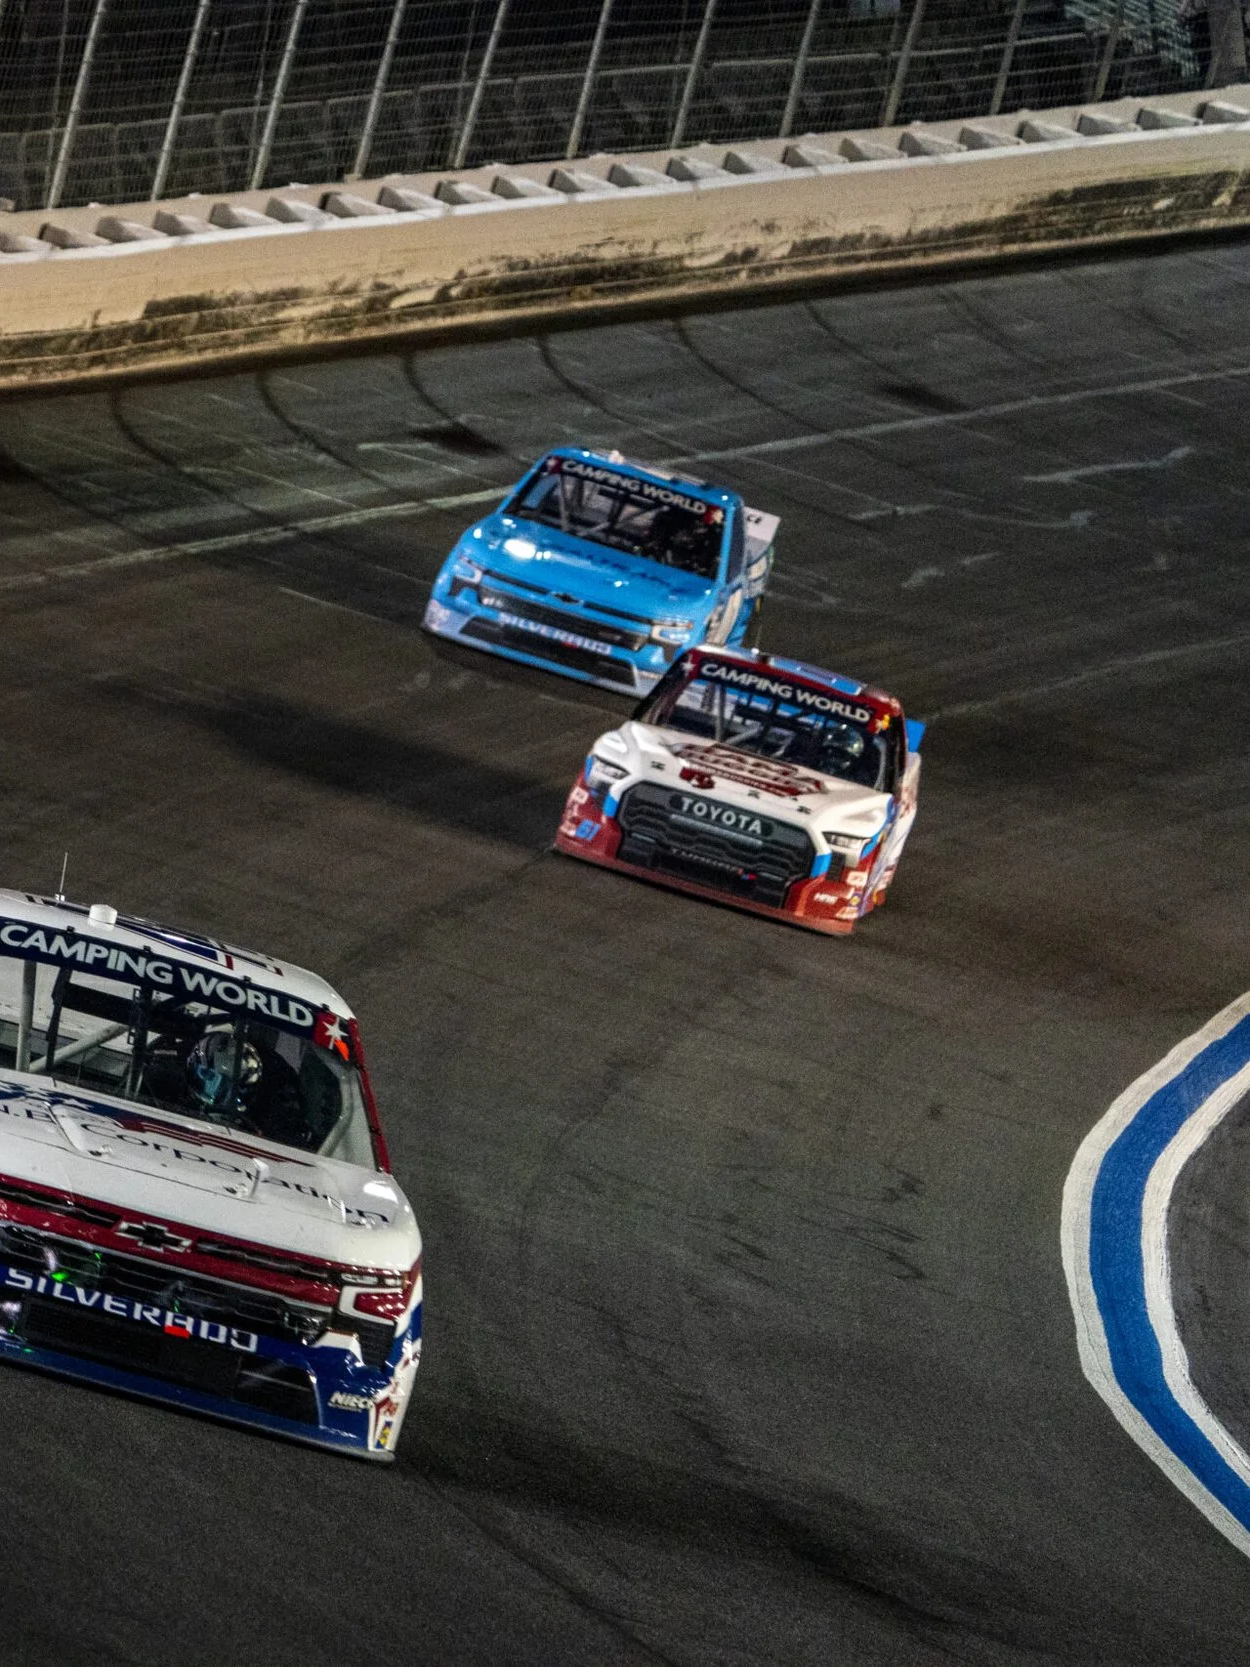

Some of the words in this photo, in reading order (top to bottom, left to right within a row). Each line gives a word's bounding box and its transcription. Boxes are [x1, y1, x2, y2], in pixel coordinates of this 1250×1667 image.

[561, 460, 641, 494] CAMPING
[643, 485, 707, 515] WORLD
[701, 663, 793, 699] CAMPING
[796, 689, 871, 723] WORLD
[681, 797, 763, 834] TOYOTA
[0, 924, 173, 985] CAMPING
[180, 967, 314, 1027] WORLD
